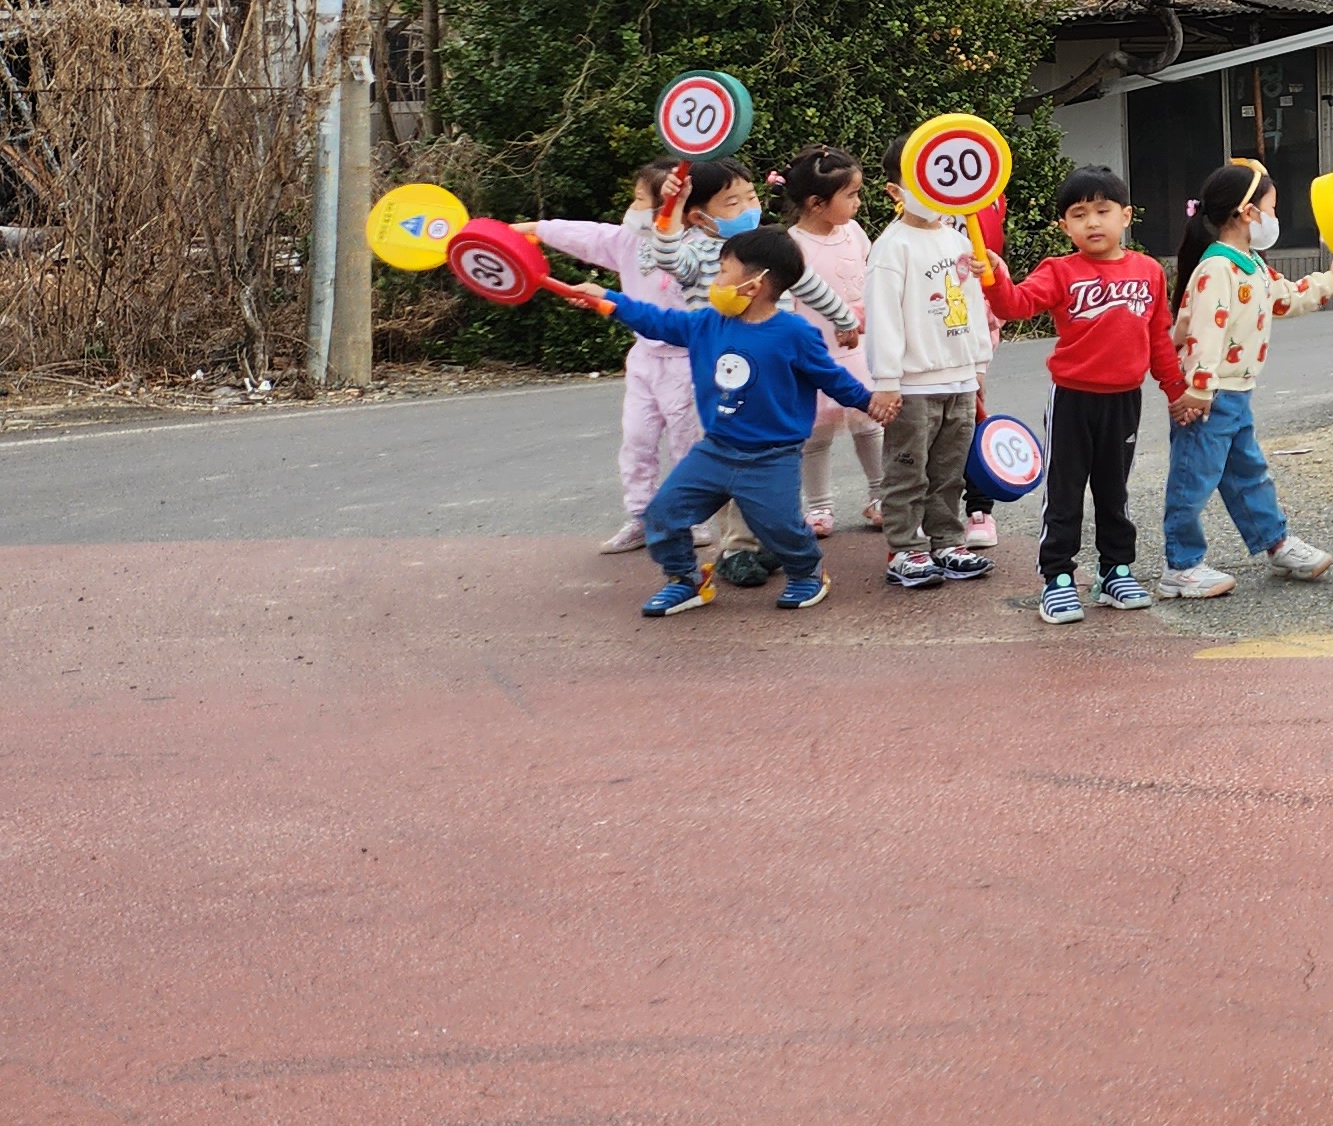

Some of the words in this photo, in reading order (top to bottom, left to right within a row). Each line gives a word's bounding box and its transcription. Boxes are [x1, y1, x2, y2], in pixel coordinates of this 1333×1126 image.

[676, 97, 716, 135] 30
[933, 148, 983, 187] 30
[471, 253, 504, 287] 30
[1068, 275, 1150, 314] Texas
